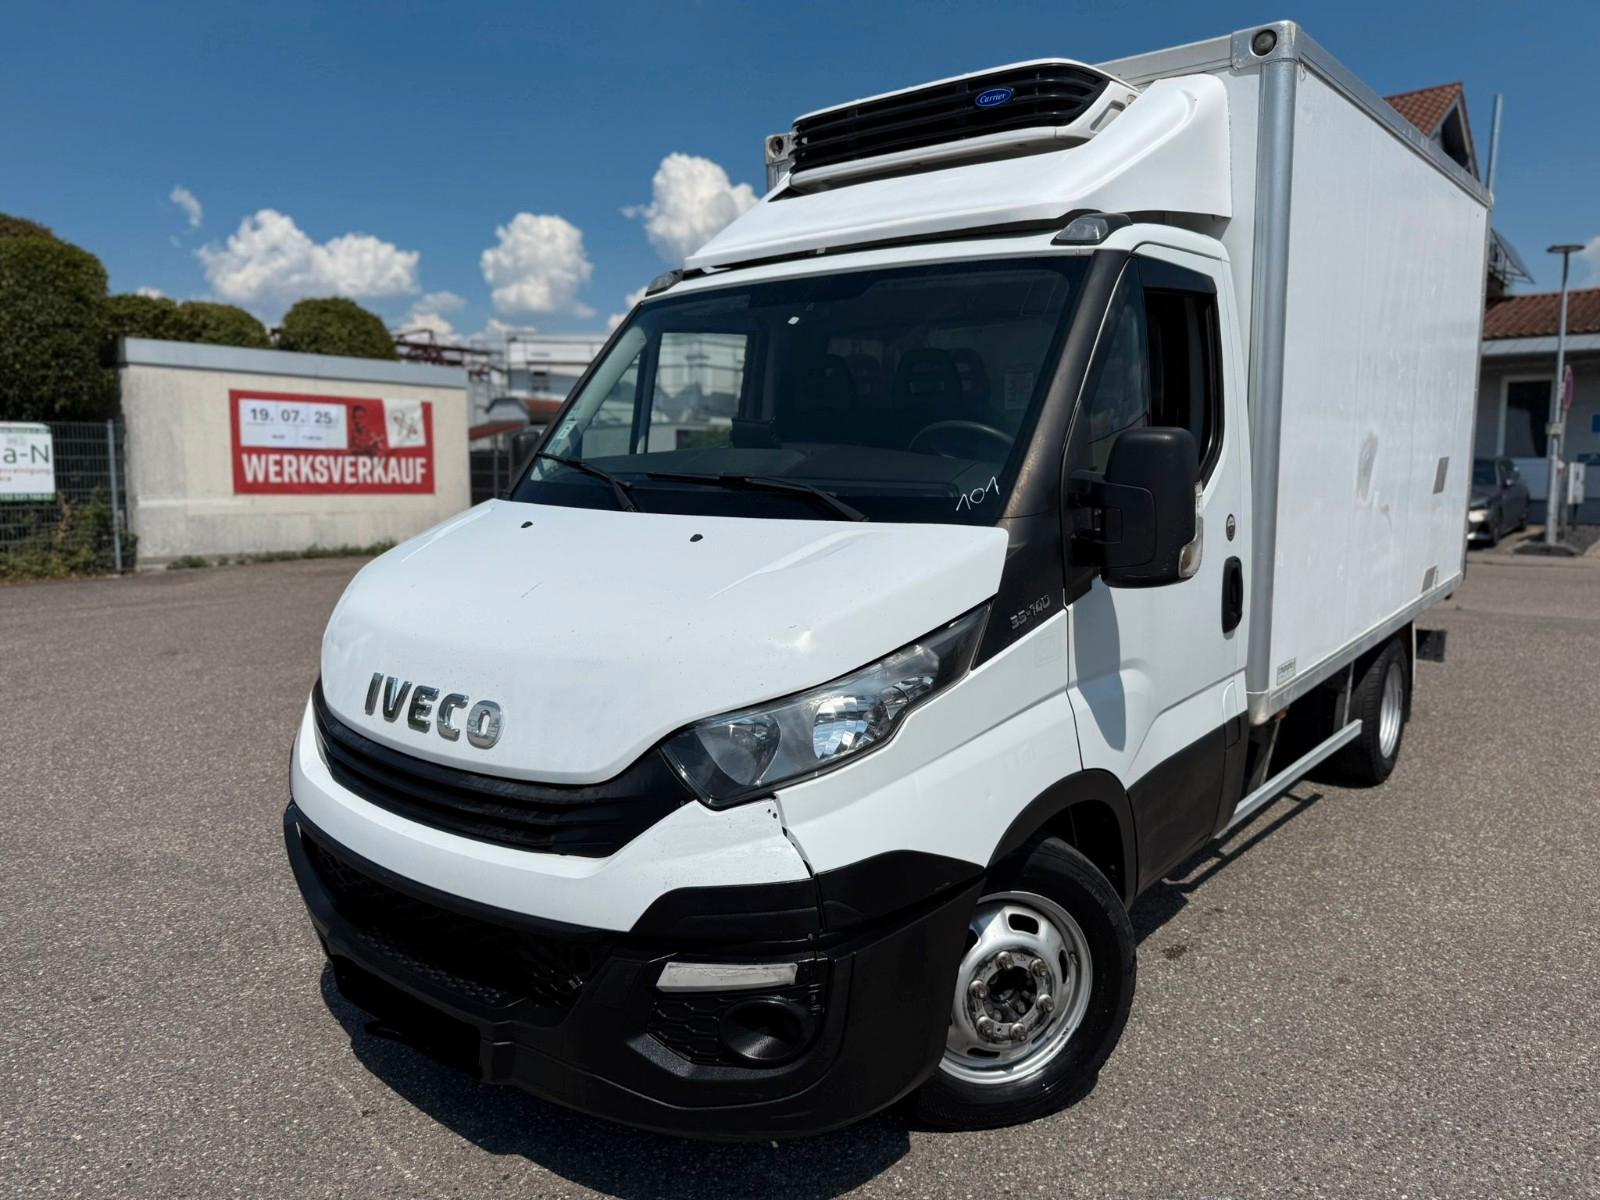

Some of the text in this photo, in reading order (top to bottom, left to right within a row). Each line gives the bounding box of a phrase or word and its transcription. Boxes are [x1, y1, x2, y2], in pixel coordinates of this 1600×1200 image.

[980, 92, 1006, 104] Carrier
[249, 407, 333, 425] 19. 07. 25
[242, 453, 427, 484] WERKSVERKAUF
[955, 476, 1000, 511] 101
[1010, 594, 1050, 629] 35-140
[364, 671, 505, 750] IVECO
